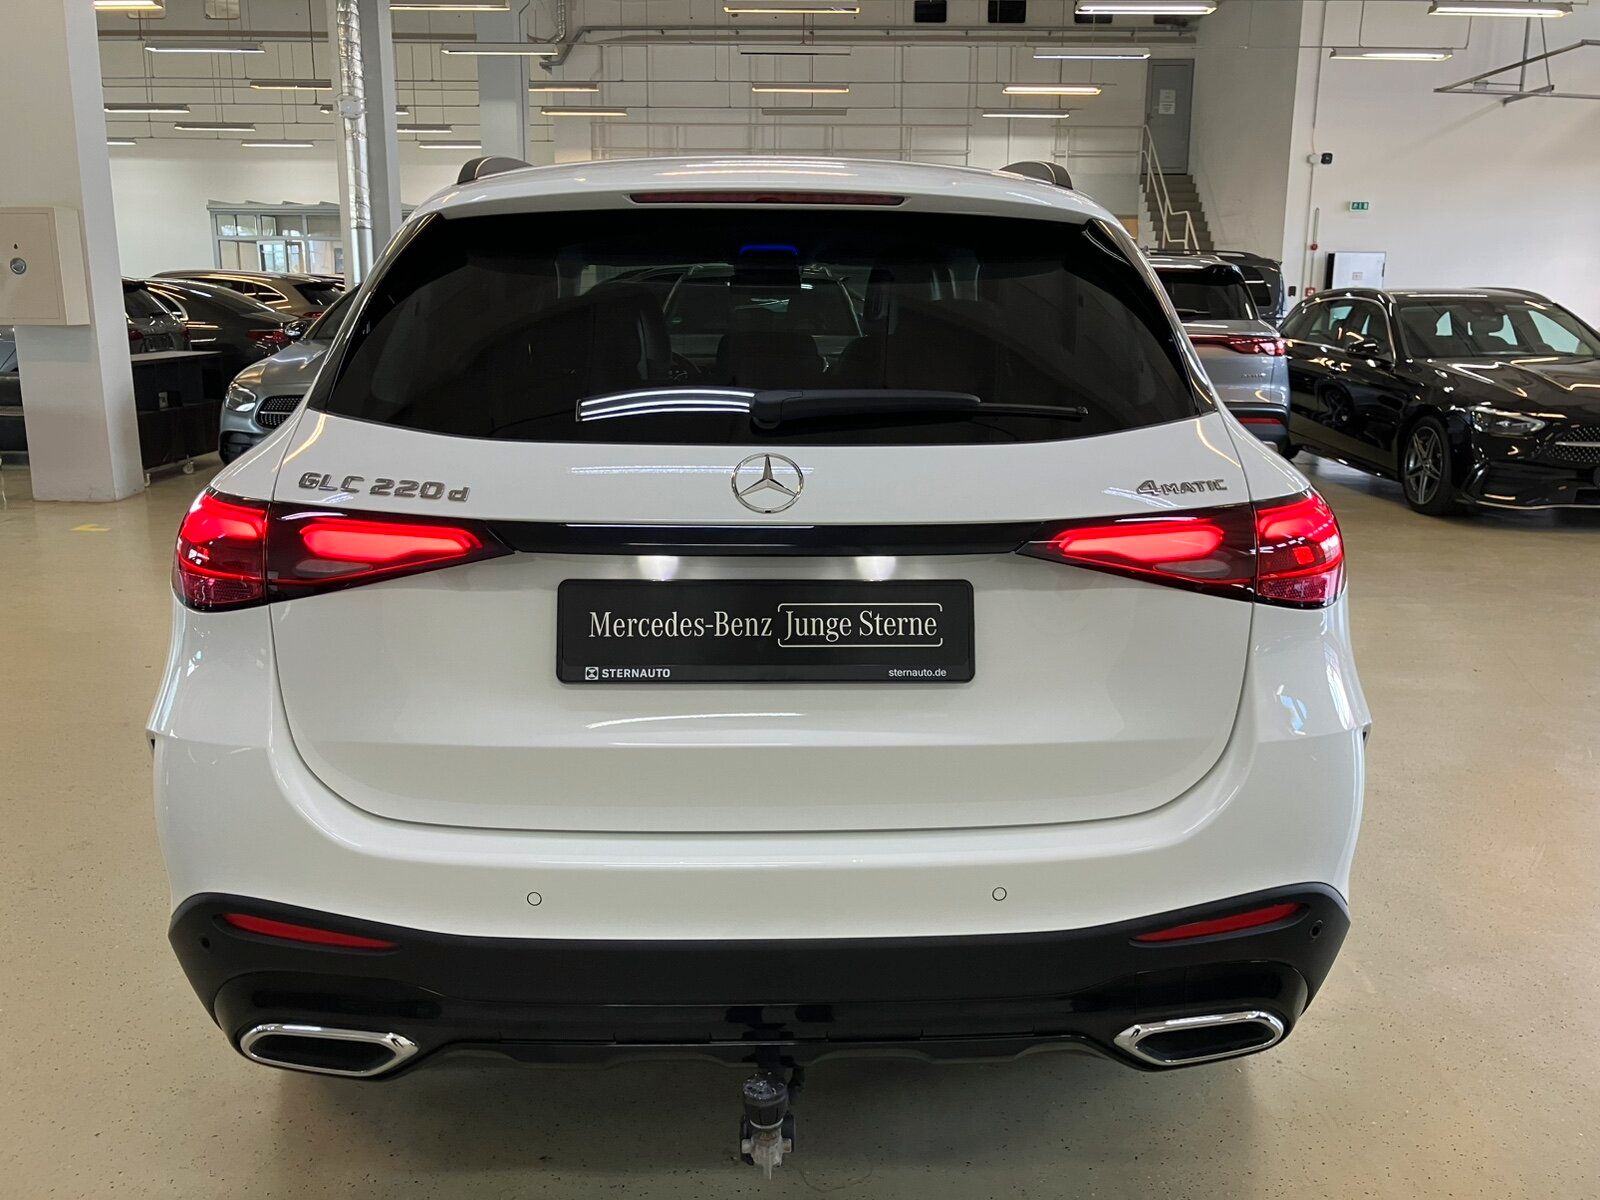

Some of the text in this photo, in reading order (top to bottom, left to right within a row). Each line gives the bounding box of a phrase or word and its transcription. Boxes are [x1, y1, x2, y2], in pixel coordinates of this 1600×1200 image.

[298, 472, 365, 493] GLC
[1136, 479, 1227, 496] 4MATIC
[588, 610, 938, 642] Mercedes-Benz Junge Sterne
[601, 668, 671, 679] STERNAUTO
[888, 668, 947, 678] sternauto.de
